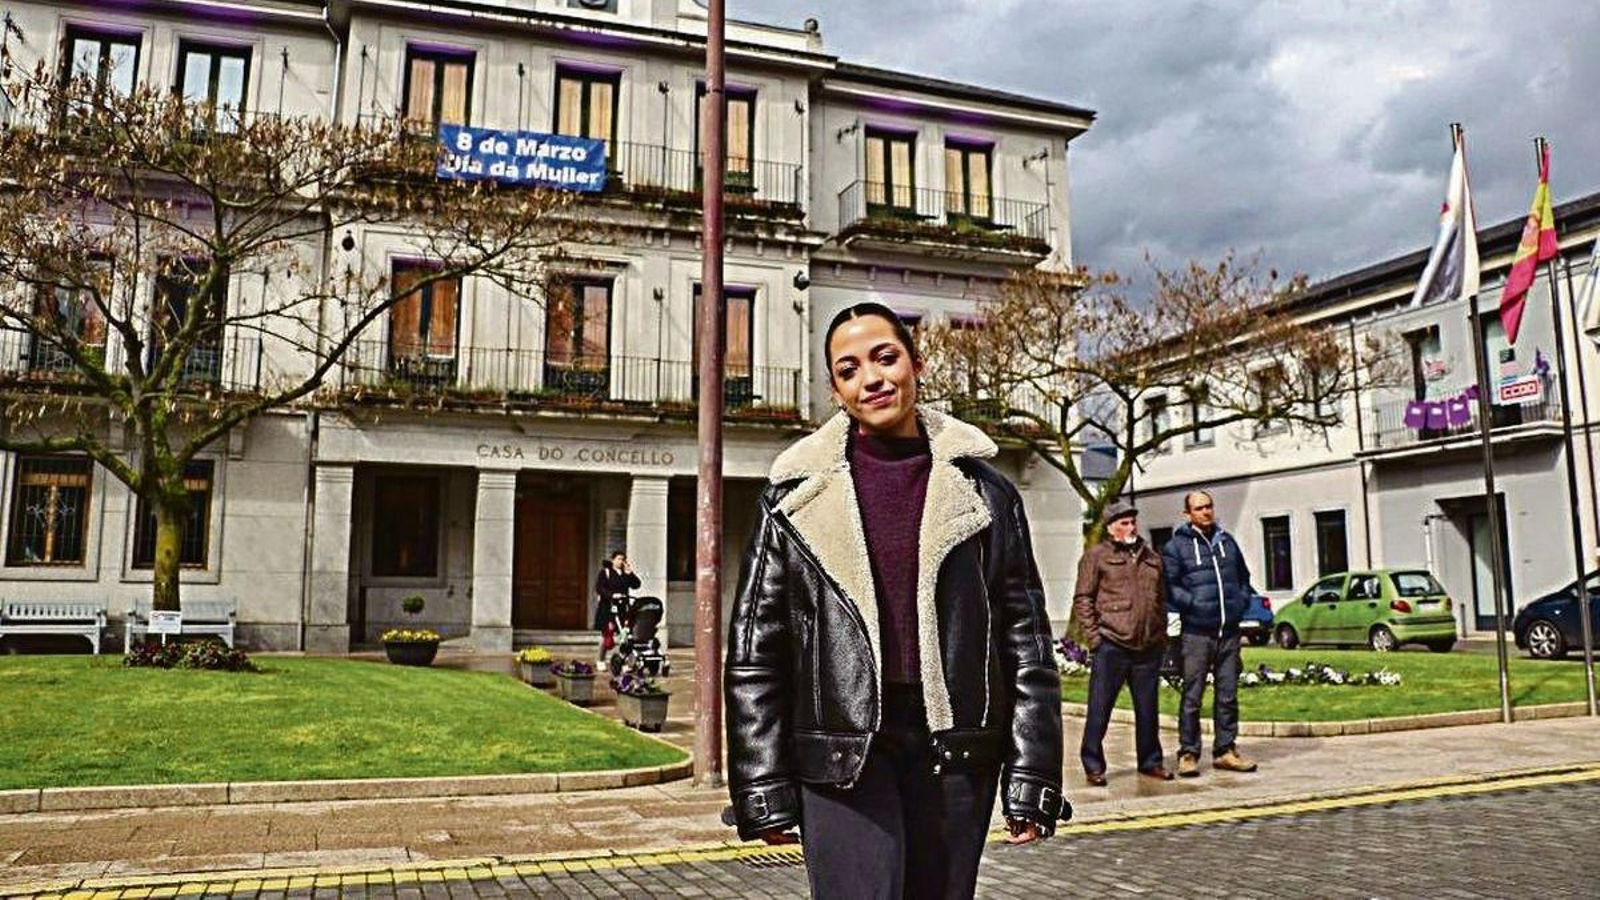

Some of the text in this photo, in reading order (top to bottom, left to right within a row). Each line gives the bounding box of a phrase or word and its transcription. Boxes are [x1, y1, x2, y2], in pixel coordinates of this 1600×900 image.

[457, 133, 588, 162] 8 de Marzo
[490, 161, 519, 178] da
[526, 162, 601, 184] Muller
[476, 444, 675, 466] CASA DO CONCELLO
